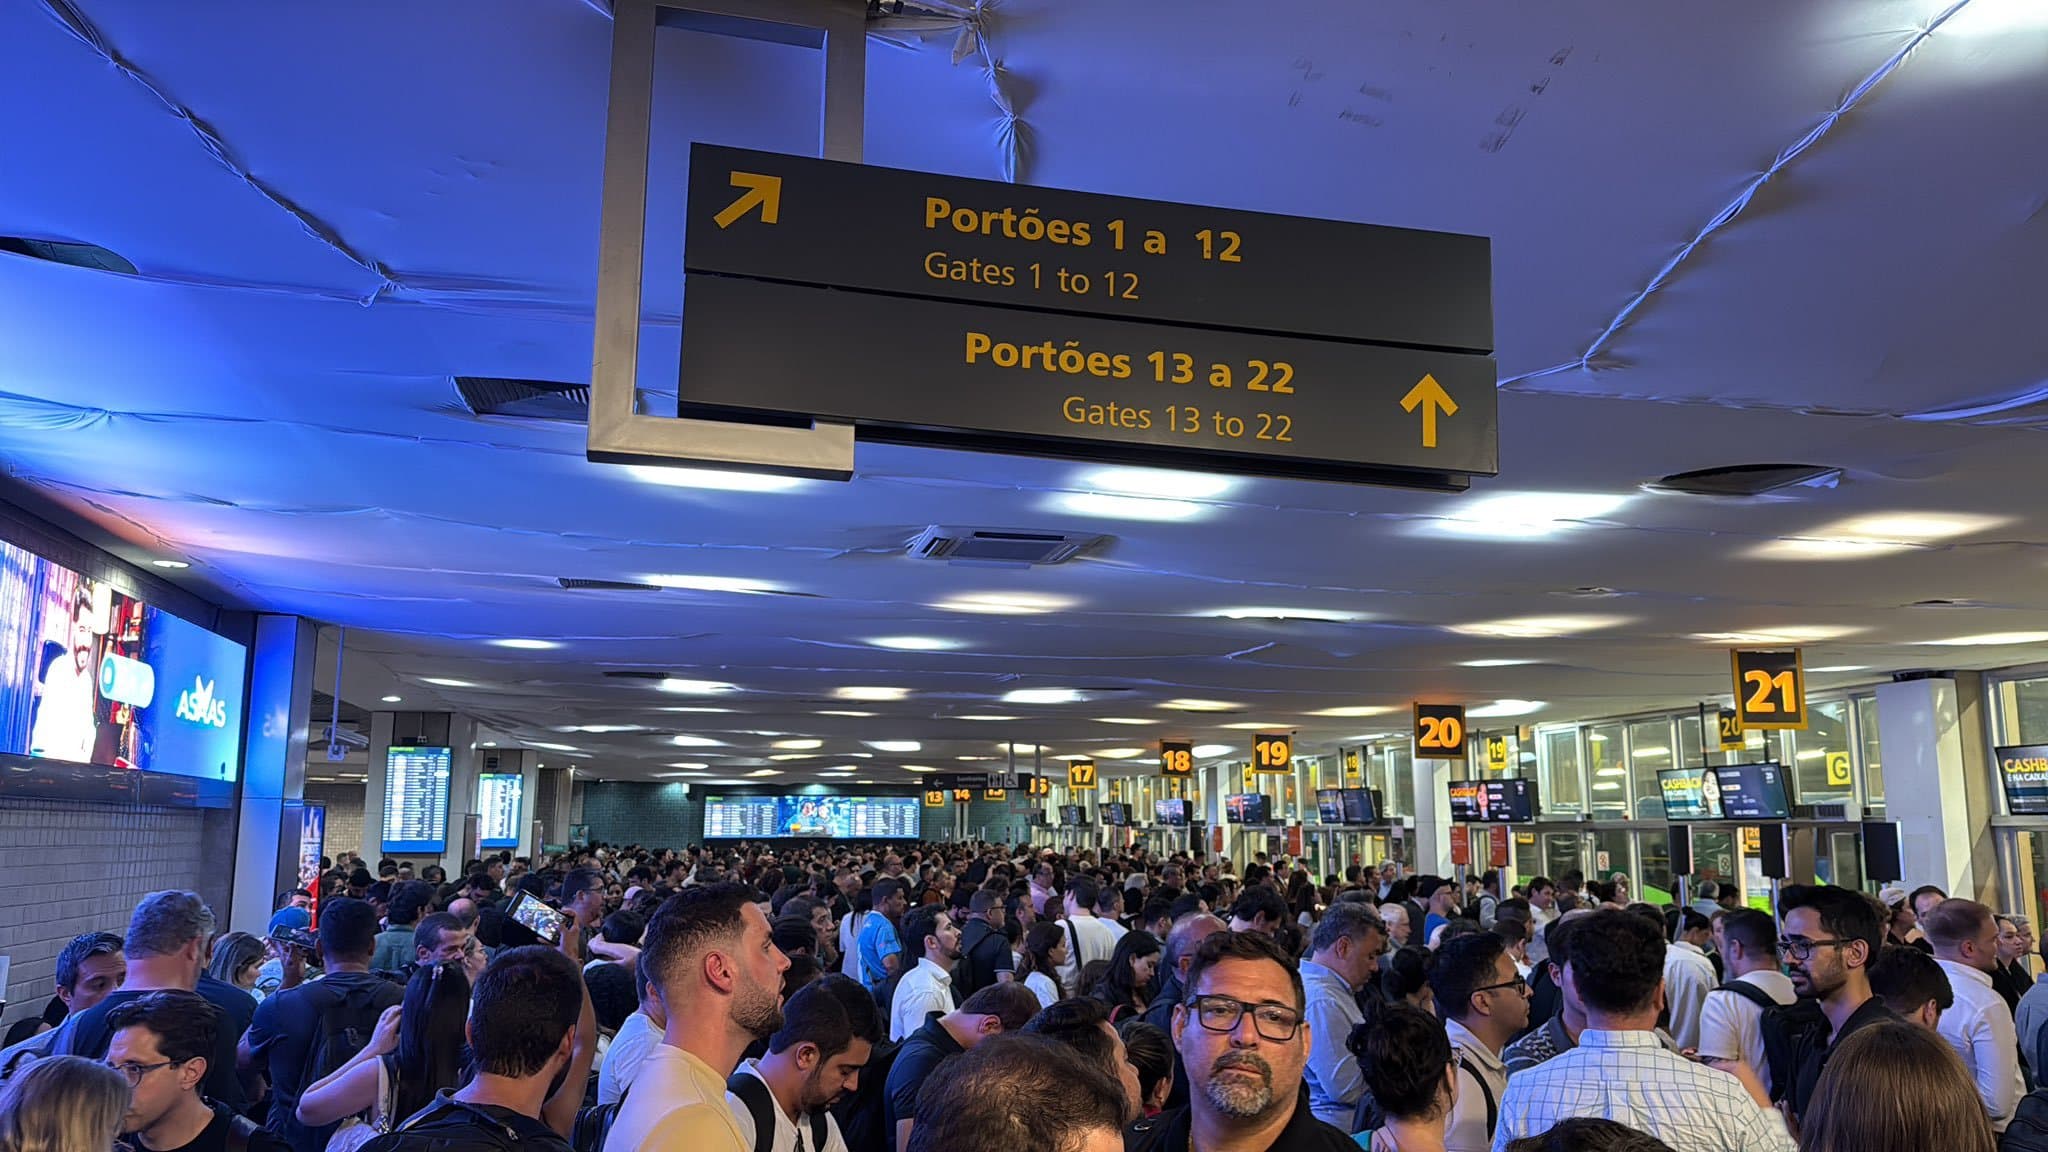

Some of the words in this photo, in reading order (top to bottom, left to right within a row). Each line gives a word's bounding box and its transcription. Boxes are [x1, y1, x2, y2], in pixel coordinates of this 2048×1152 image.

[925, 197, 1092, 246] Portões
[1107, 219, 1124, 250] 1
[1143, 230, 1167, 255] a
[1195, 229, 1242, 263] 12
[924, 252, 1015, 286] Gates
[1030, 263, 1040, 289] 1
[1057, 269, 1090, 294] to
[1104, 271, 1139, 300] 12
[965, 332, 1132, 379] Portões
[1147, 351, 1194, 385] 13
[1208, 363, 1232, 389] a
[1246, 359, 1295, 395] 22
[1062, 395, 1153, 431] Gates
[1166, 404, 1201, 436] 13
[1211, 411, 1245, 439] to
[1255, 412, 1293, 443] 22
[1744, 670, 1796, 713] 21
[1419, 716, 1462, 749] 20
[1721, 716, 1741, 736] 20
[1162, 750, 1191, 772] 18
[1255, 741, 1289, 767] 19
[1490, 742, 1504, 759] 19
[1071, 765, 1094, 783] 17
[1832, 755, 1849, 780] G
[928, 791, 943, 803] 13
